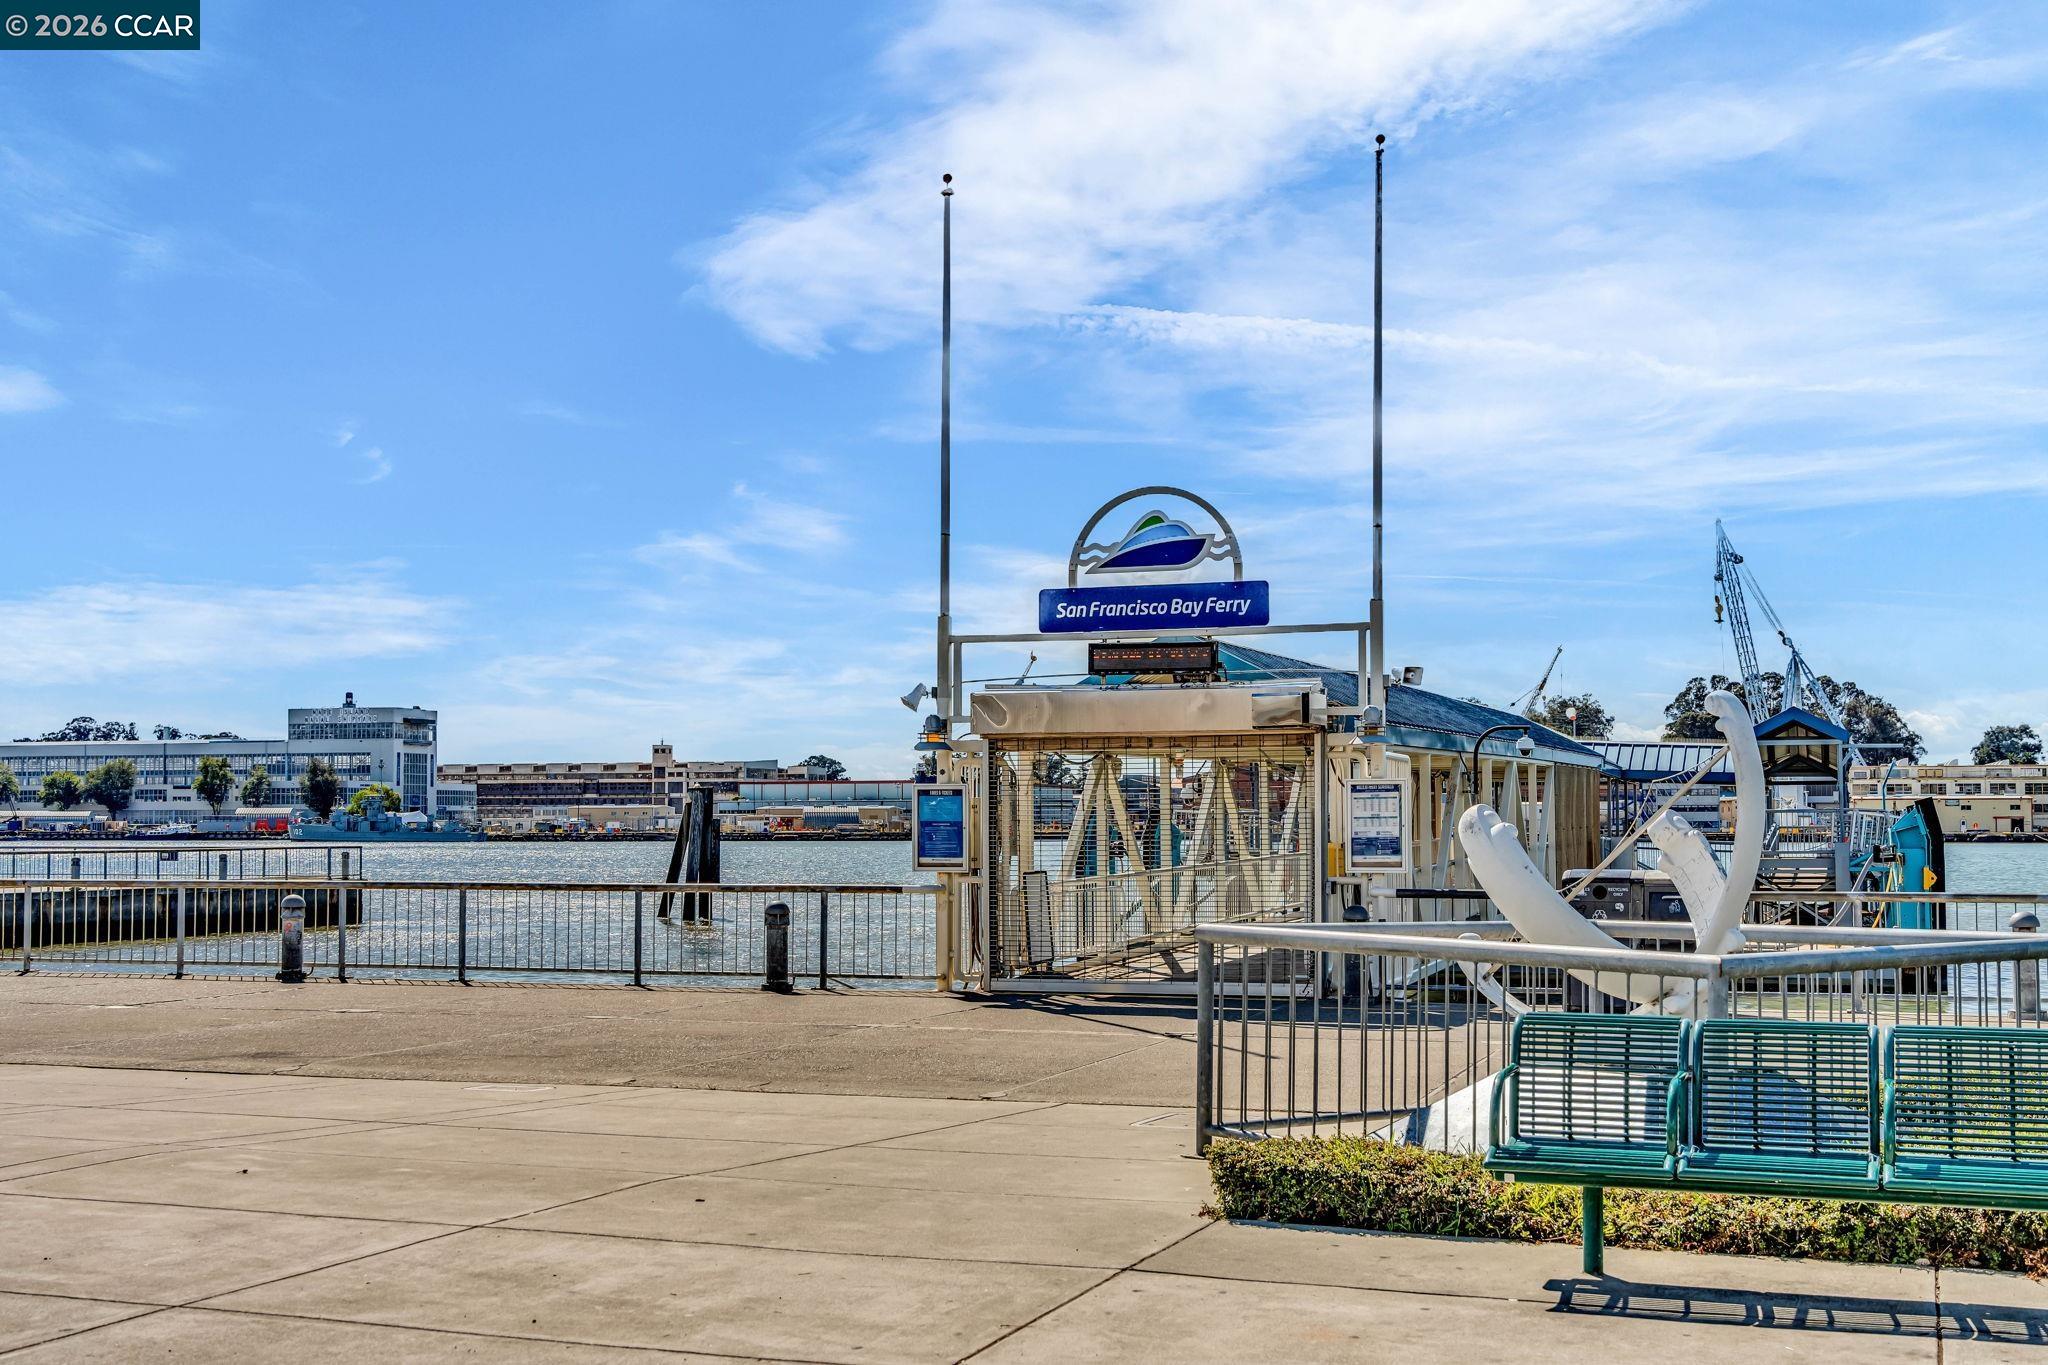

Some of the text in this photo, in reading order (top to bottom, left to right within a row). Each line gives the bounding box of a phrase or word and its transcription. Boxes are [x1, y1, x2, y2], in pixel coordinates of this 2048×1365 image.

[1056, 597, 1252, 619] San Francisco Bay Ferry
